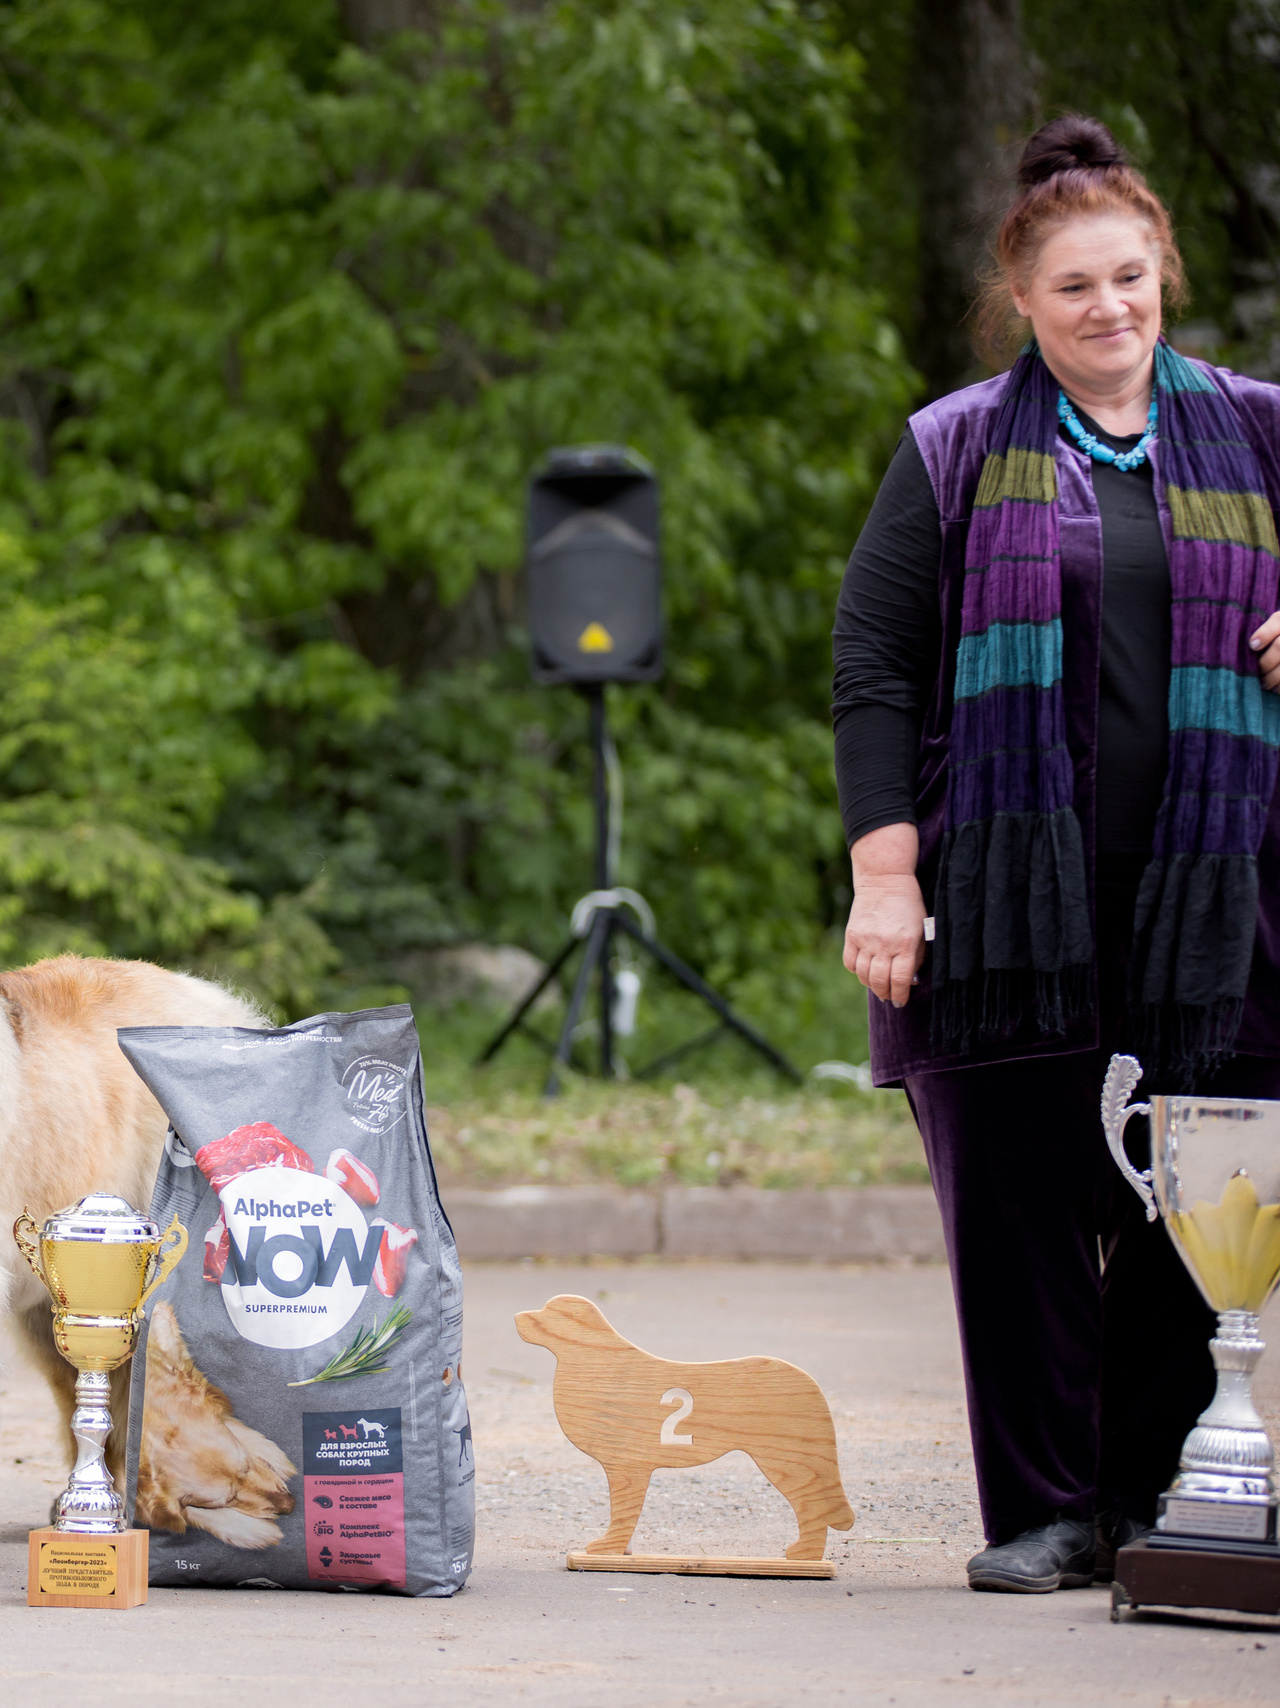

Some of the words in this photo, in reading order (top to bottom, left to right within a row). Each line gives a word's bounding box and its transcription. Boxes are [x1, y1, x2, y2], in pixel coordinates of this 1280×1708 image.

[233, 1198, 333, 1221] AlphaPet
[245, 1304, 328, 1314] SUPERPREMIUM
[660, 1386, 694, 1445] 2
[320, 1443, 338, 1451] ДЛЯ
[340, 1441, 387, 1450] ВЗРОСЛЫХ
[347, 1449, 390, 1458] КРУПНЫХ
[339, 1459, 371, 1467] ПОРОД
[339, 1551, 381, 1560] Здоровые
[174, 1560, 188, 1570] 15
[451, 1561, 461, 1574] 15
